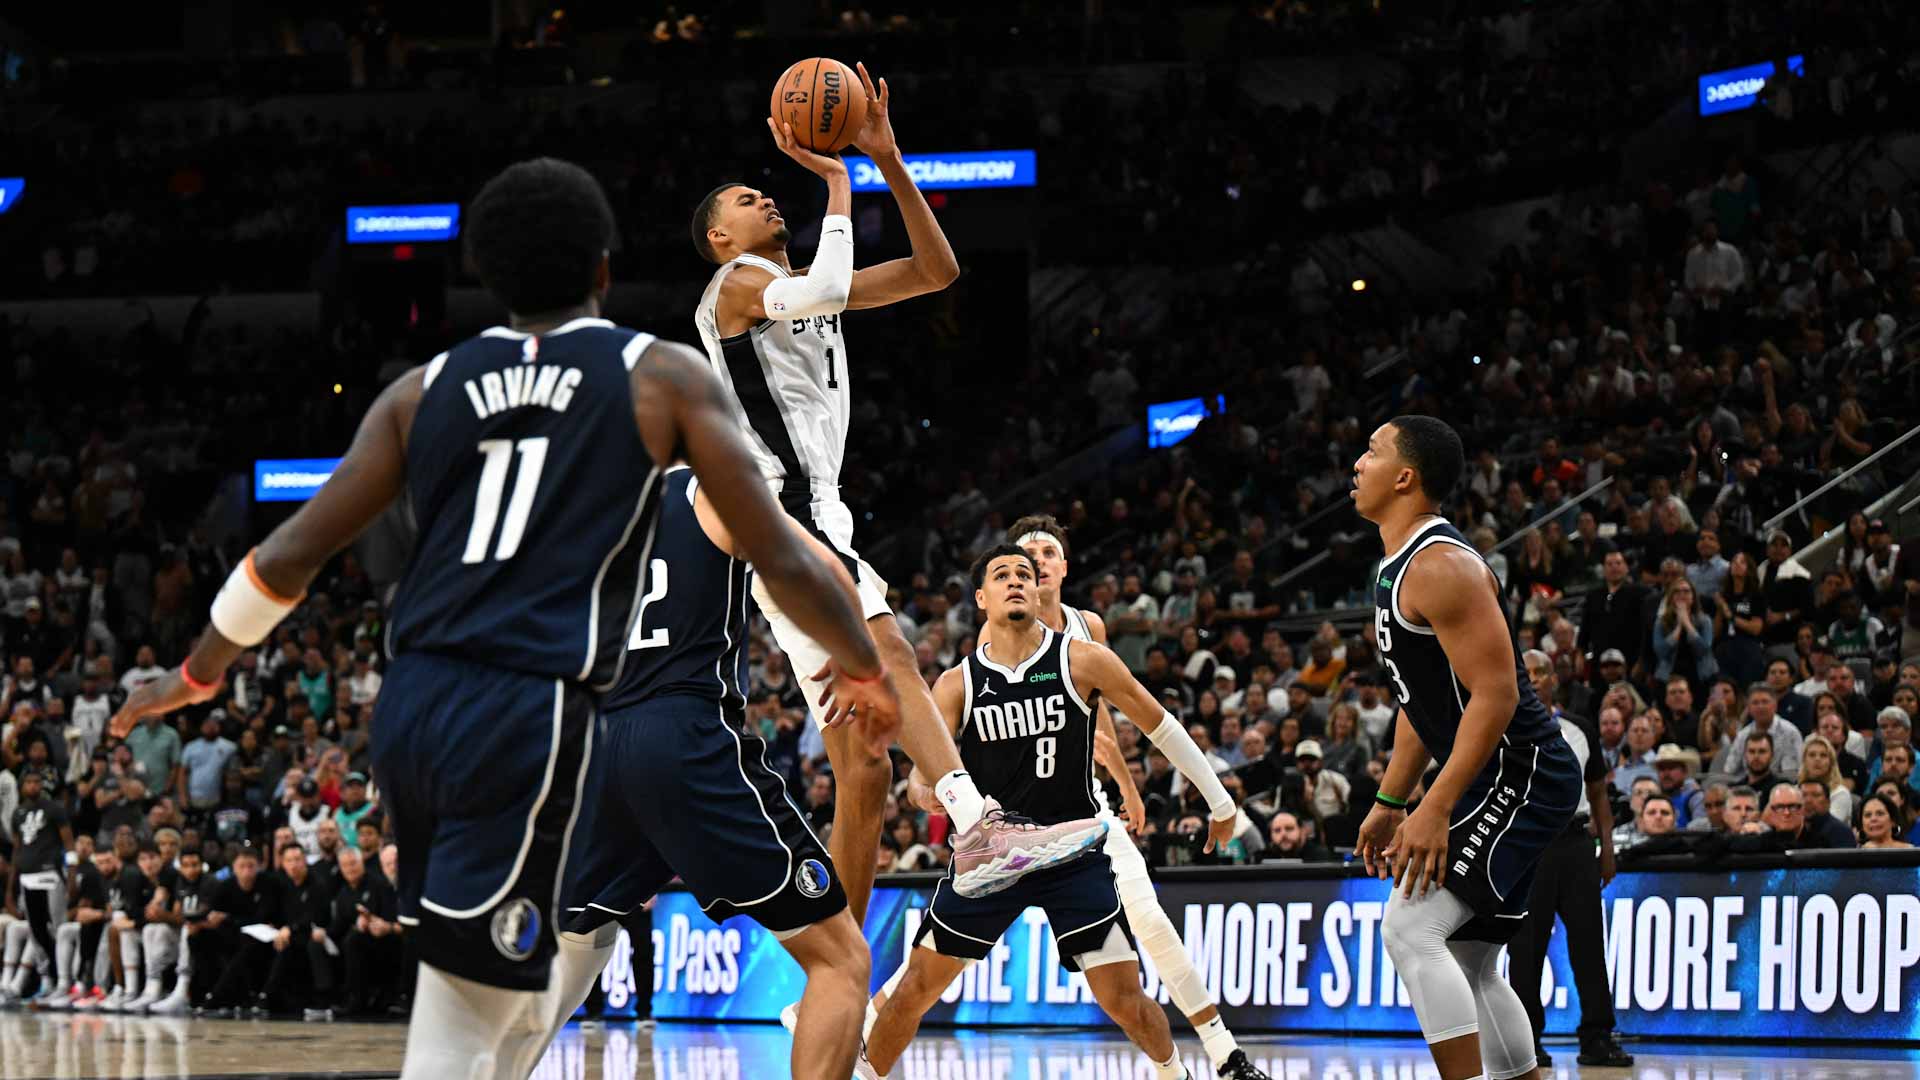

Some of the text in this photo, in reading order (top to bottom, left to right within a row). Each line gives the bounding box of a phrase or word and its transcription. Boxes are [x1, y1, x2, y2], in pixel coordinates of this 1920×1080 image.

[819, 71, 841, 133] Wilson
[464, 364, 583, 420] IRVING
[825, 347, 839, 390] 1
[461, 437, 550, 564] 11
[626, 558, 670, 651] 2
[1029, 671, 1058, 683] chime
[973, 694, 1067, 742] MAVS
[1035, 737, 1057, 779] 8
[667, 913, 741, 994] Pass
[1184, 901, 1313, 1007] MORE
[1601, 894, 1745, 1011] MORE
